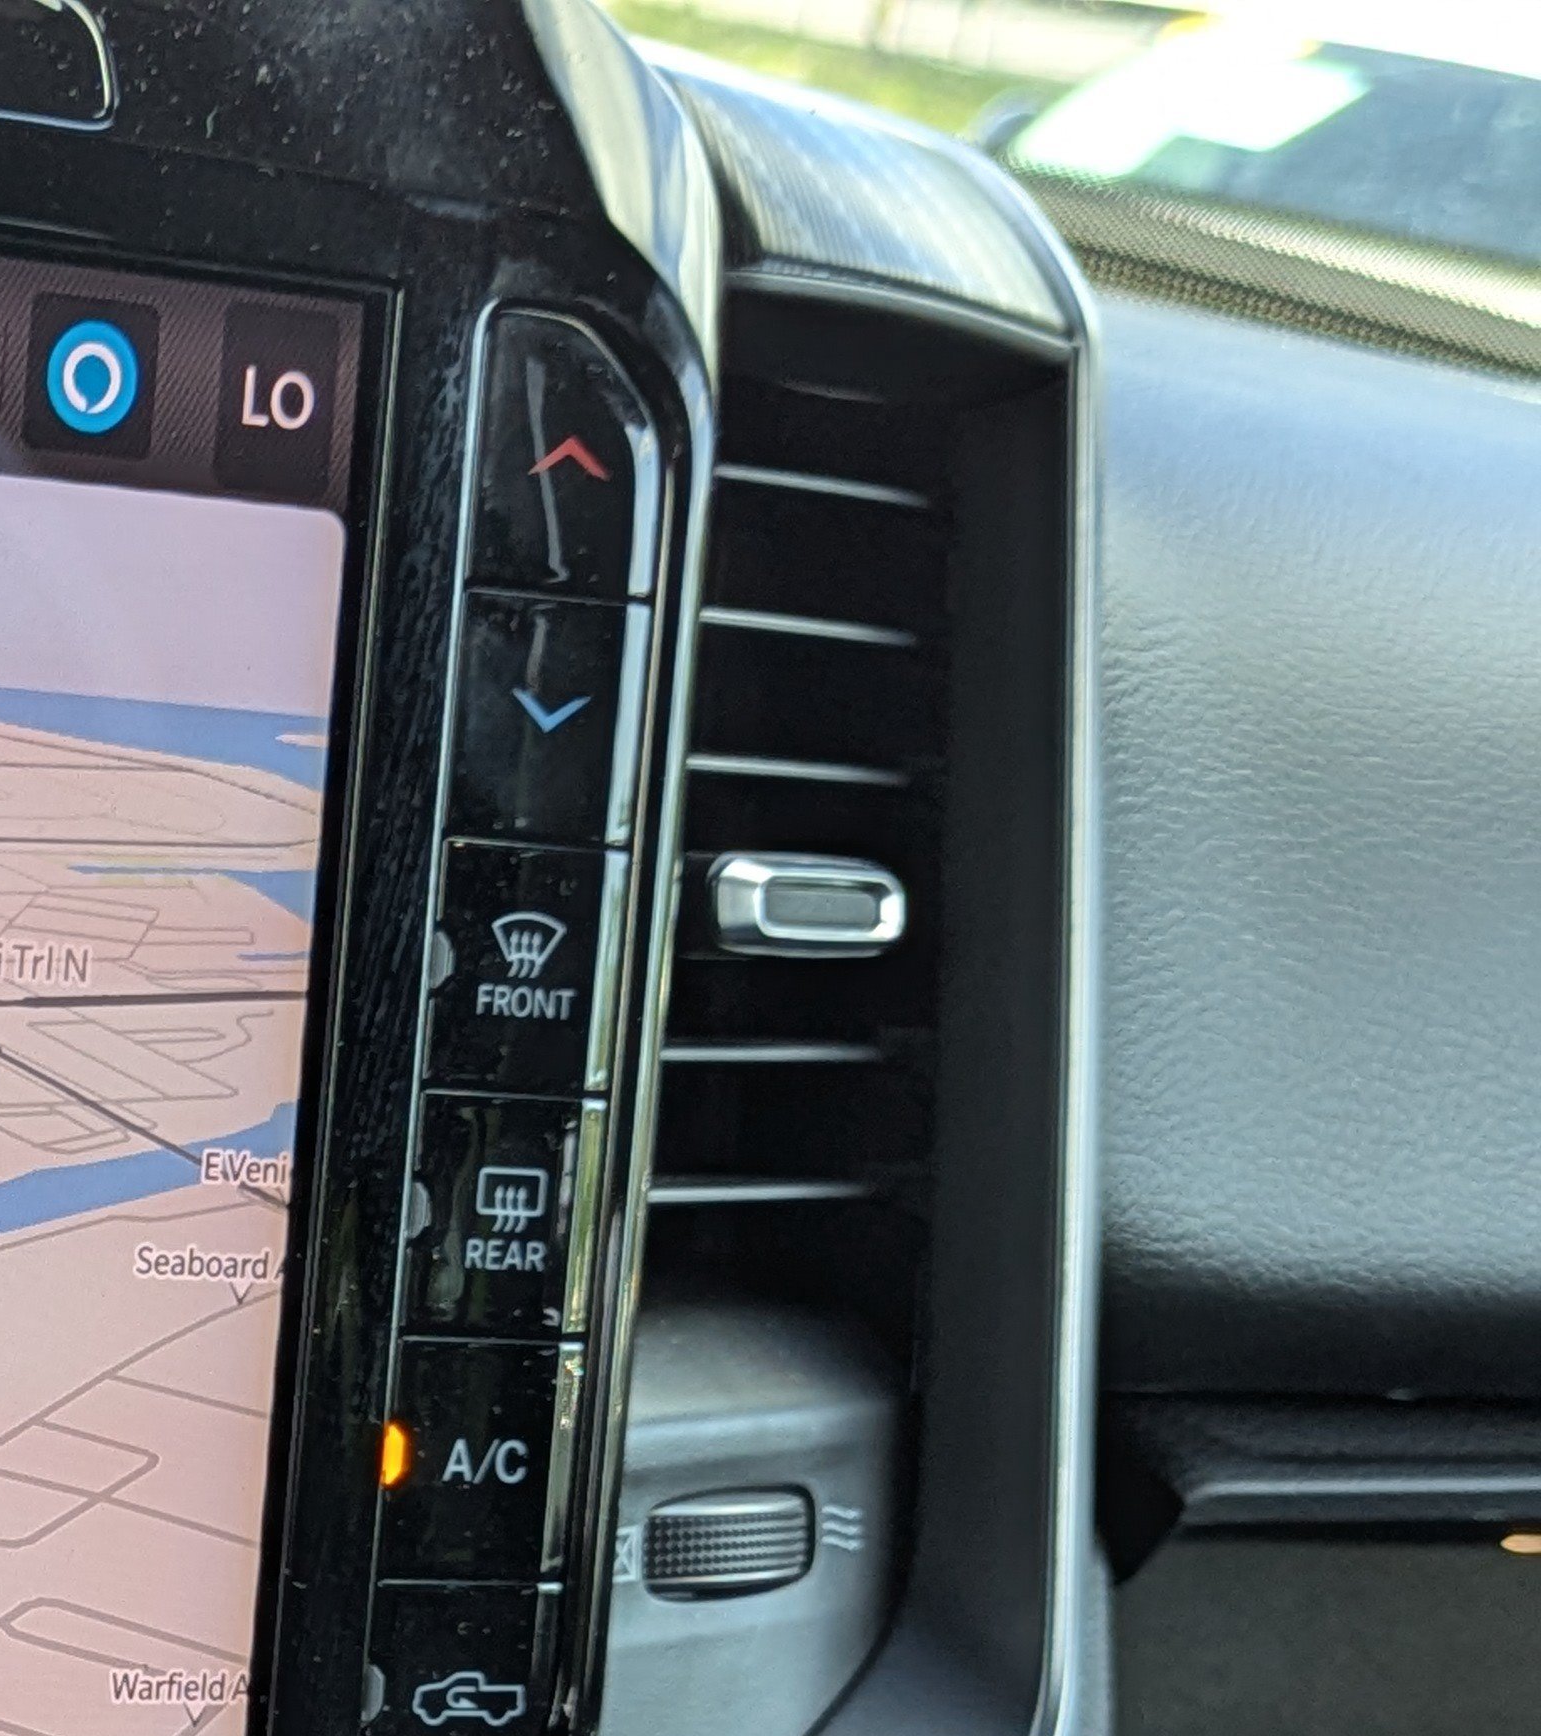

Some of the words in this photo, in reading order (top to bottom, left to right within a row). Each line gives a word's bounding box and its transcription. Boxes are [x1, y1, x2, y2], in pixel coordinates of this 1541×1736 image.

[242, 365, 315, 431] LO
[12, 945, 56, 981] Trl
[63, 949, 90, 983] N
[476, 983, 575, 1022] FRONT
[205, 1152, 221, 1180] E
[228, 1154, 288, 1184] Veni
[136, 1245, 269, 1279] Seaboard
[464, 1238, 547, 1274] REAR
[443, 1438, 529, 1483] A/C
[111, 1671, 226, 1703] Warfield
